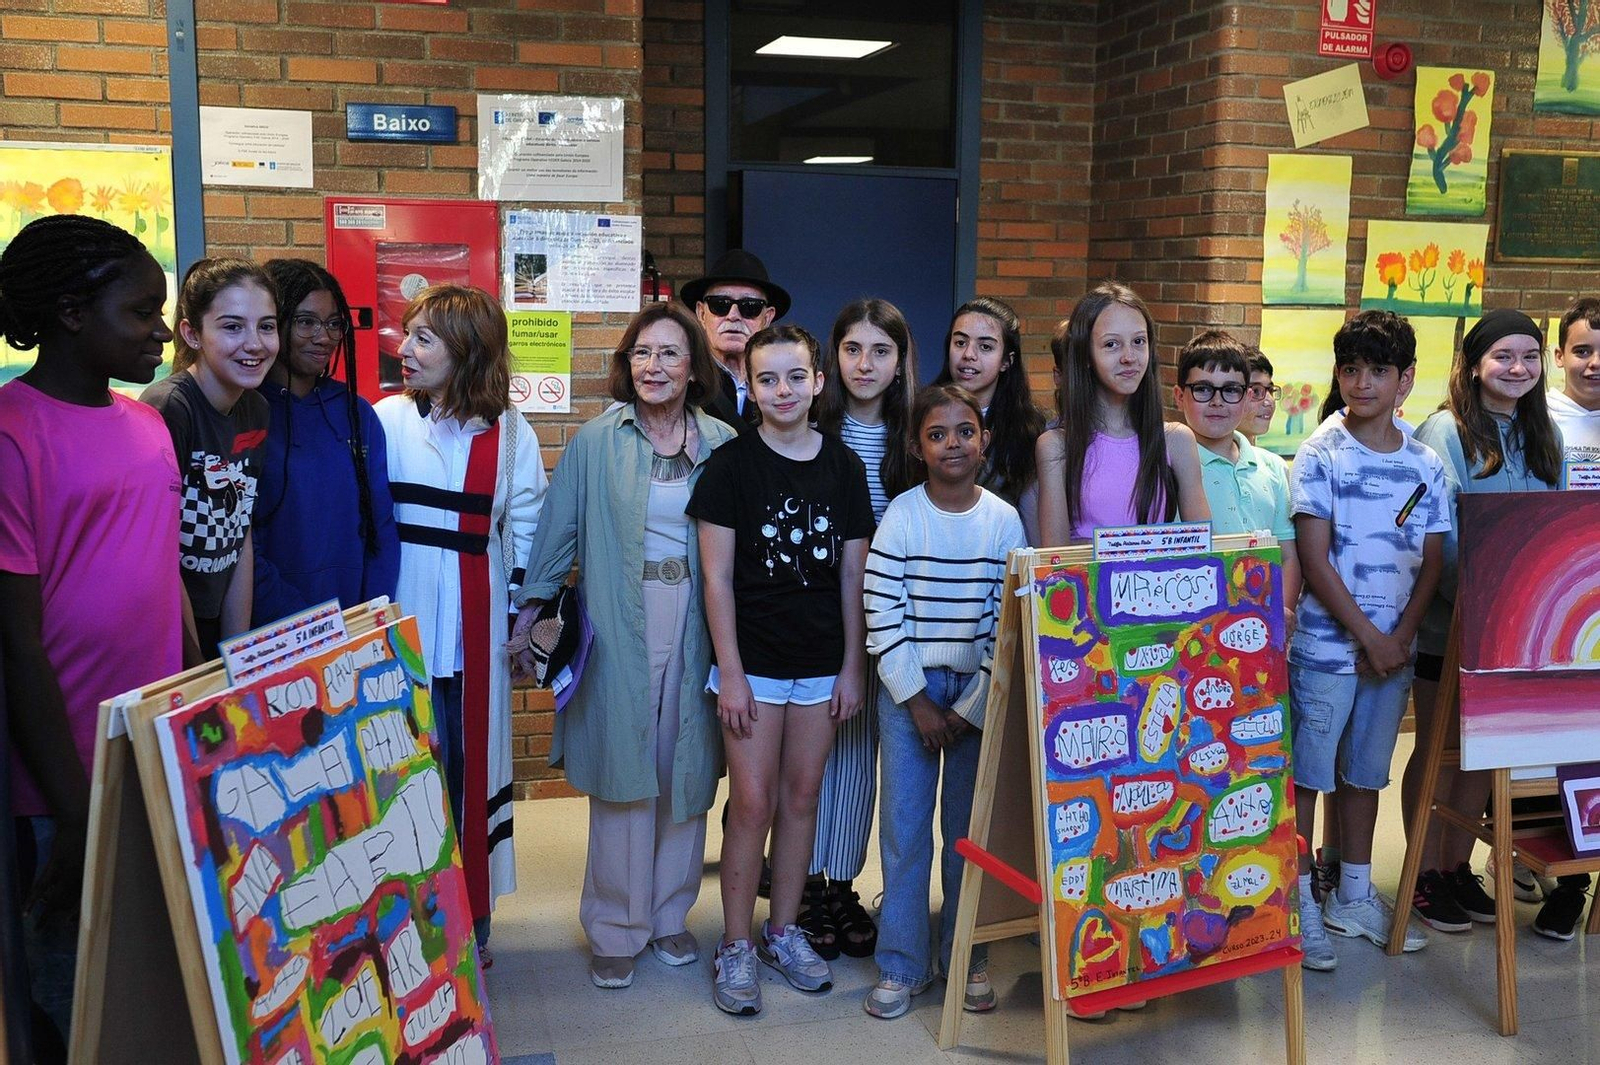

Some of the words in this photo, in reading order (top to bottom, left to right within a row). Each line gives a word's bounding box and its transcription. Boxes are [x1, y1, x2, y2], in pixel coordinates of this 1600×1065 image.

[1324, 31, 1368, 42] PULSADOR
[1322, 43, 1333, 51] DE
[1334, 44, 1368, 54] ALARMA
[373, 114, 431, 132] Baixo
[512, 318, 559, 327] prohibido
[512, 330, 558, 338] fumar/usar
[1174, 535, 1200, 544] INFANTIL
[308, 619, 336, 640] INFANTIL
[1222, 628, 1260, 645] JORGE
[1143, 683, 1176, 752] ESTELA
[1062, 875, 1084, 886] EDDY
[1109, 872, 1177, 898] MARTINA
[407, 982, 454, 1041] JULIA
